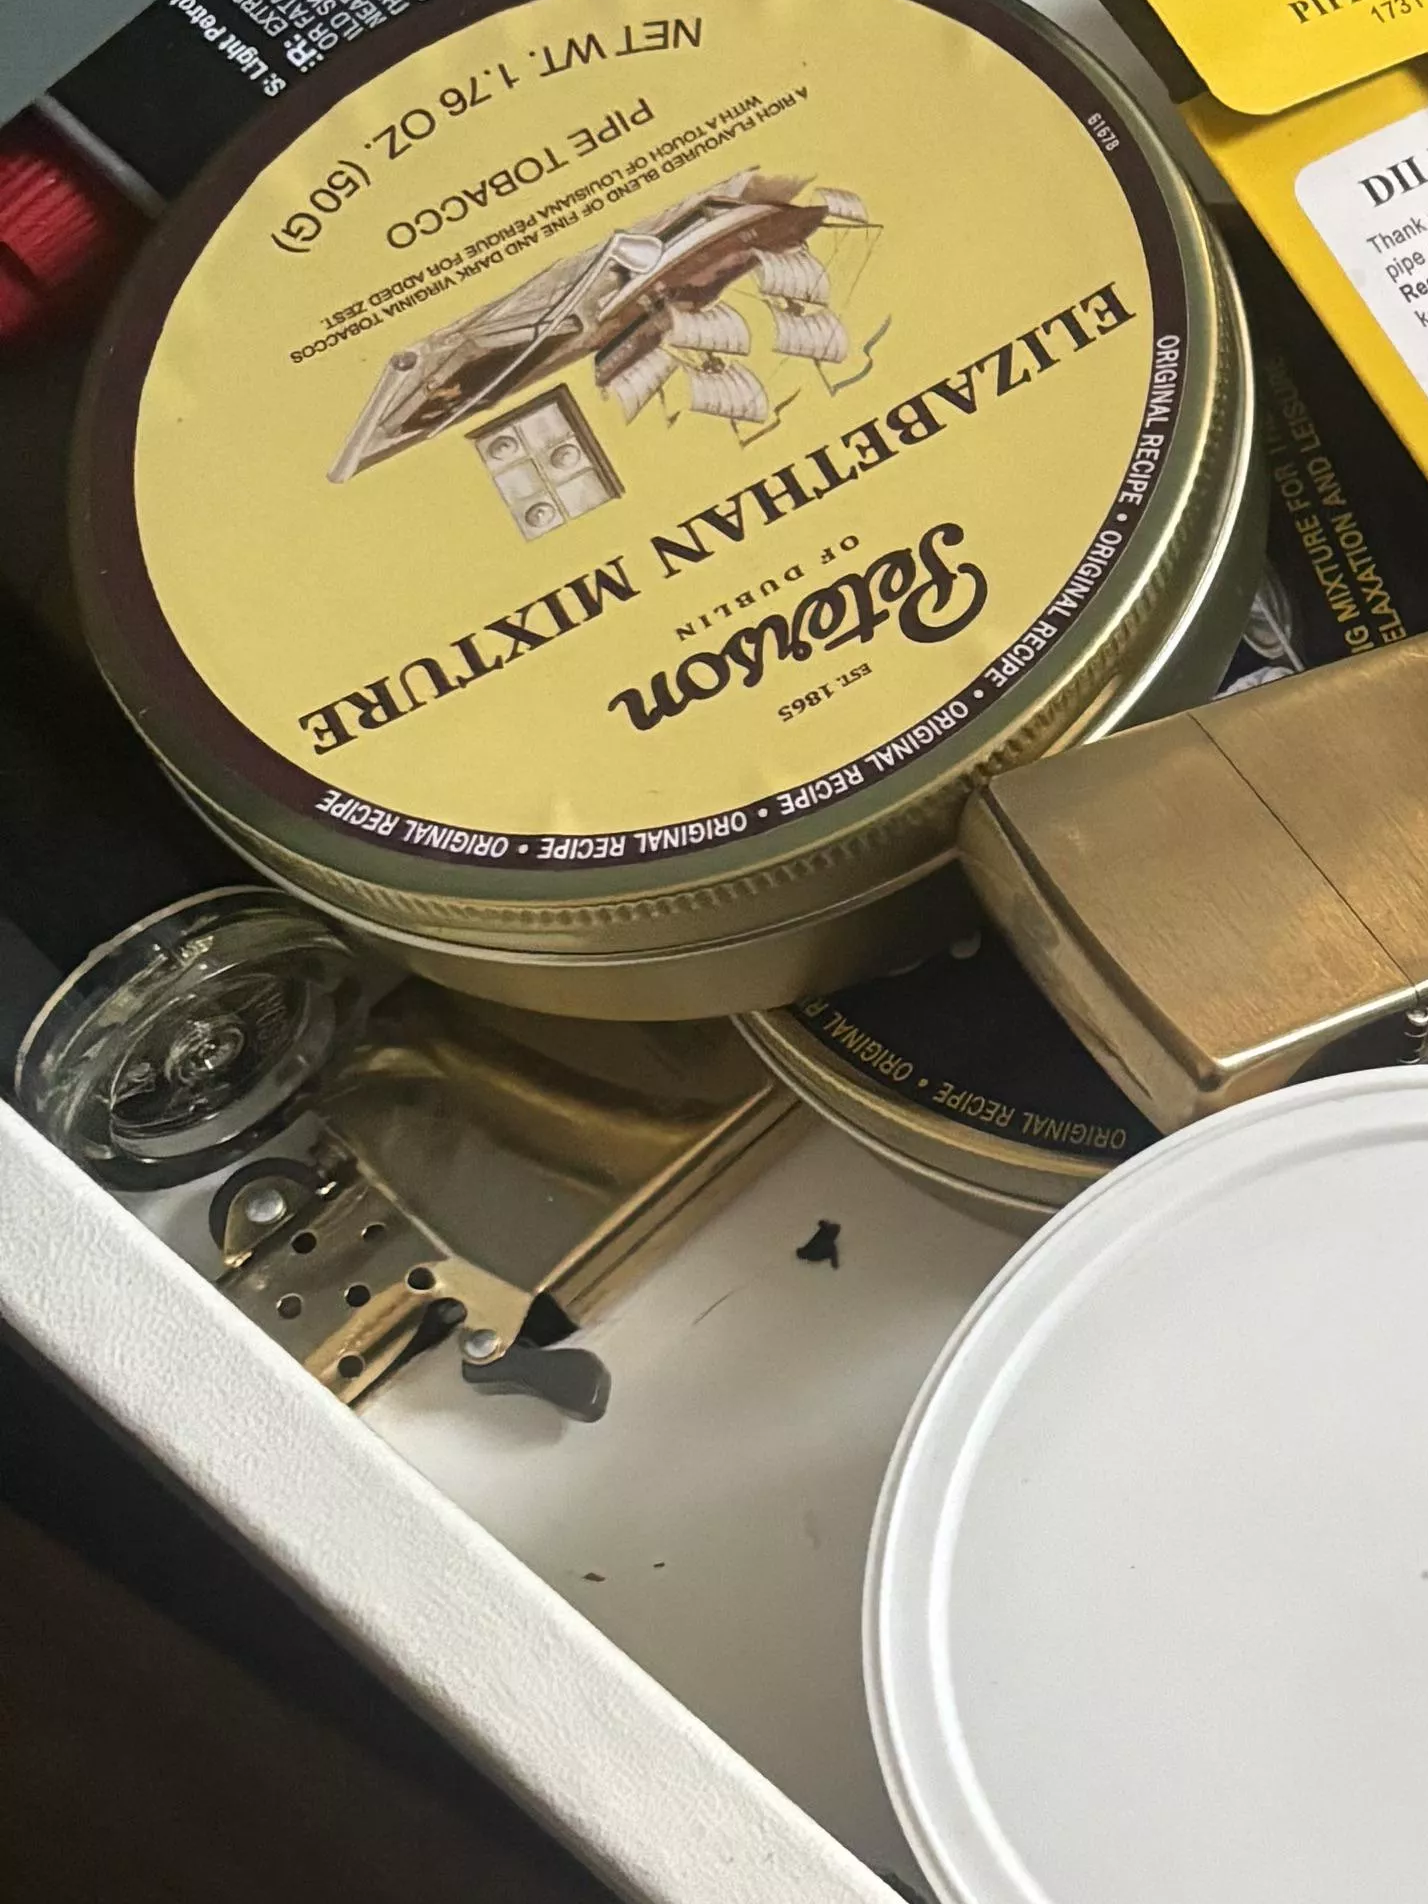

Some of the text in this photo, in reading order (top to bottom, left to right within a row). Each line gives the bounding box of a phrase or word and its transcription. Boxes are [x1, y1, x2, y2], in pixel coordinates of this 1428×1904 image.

[216, 30, 270, 82] Light
[529, 32, 605, 77] WT.
[616, 16, 702, 54] NET
[439, 64, 518, 118] 1.76
[716, 93, 762, 124] WITH
[364, 110, 436, 160] OZ.
[646, 124, 705, 162] TOUCH
[1086, 110, 1121, 152] 61678
[383, 96, 655, 252] PIPE TOBACCO
[624, 154, 648, 175] OF
[536, 168, 623, 220] LOUISIANA
[288, 92, 796, 366] RICH FLAVOURED BLEND OF FINE AND DARK VIRGINIA TOBACCOS
[1365, 214, 1428, 255] Thank
[366, 269, 425, 308] ADDED
[424, 250, 463, 278] FOR
[1384, 249, 1427, 283] pipe
[318, 299, 367, 332] ZEST.
[1272, 462, 1311, 512] FOR
[1304, 454, 1347, 508] AND
[297, 282, 1134, 758] ELIZABETHAN MIXTURE
[674, 534, 860, 642] OF DUBLIN
[1294, 513, 1360, 624] MIXTURE
[1330, 510, 1406, 643] ELAXATION
[316, 334, 1180, 860] ORIGINAL RECIPE ORIGINAL RECIPE ORIGINAL RECIPE ORIGINAL RECIPE ORIGINAL RECIPE
[608, 523, 988, 733] Peterson
[776, 662, 872, 722] EST. 1865
[824, 1012, 1127, 1149] ORIGINAL RECIPE ORIGINAL
